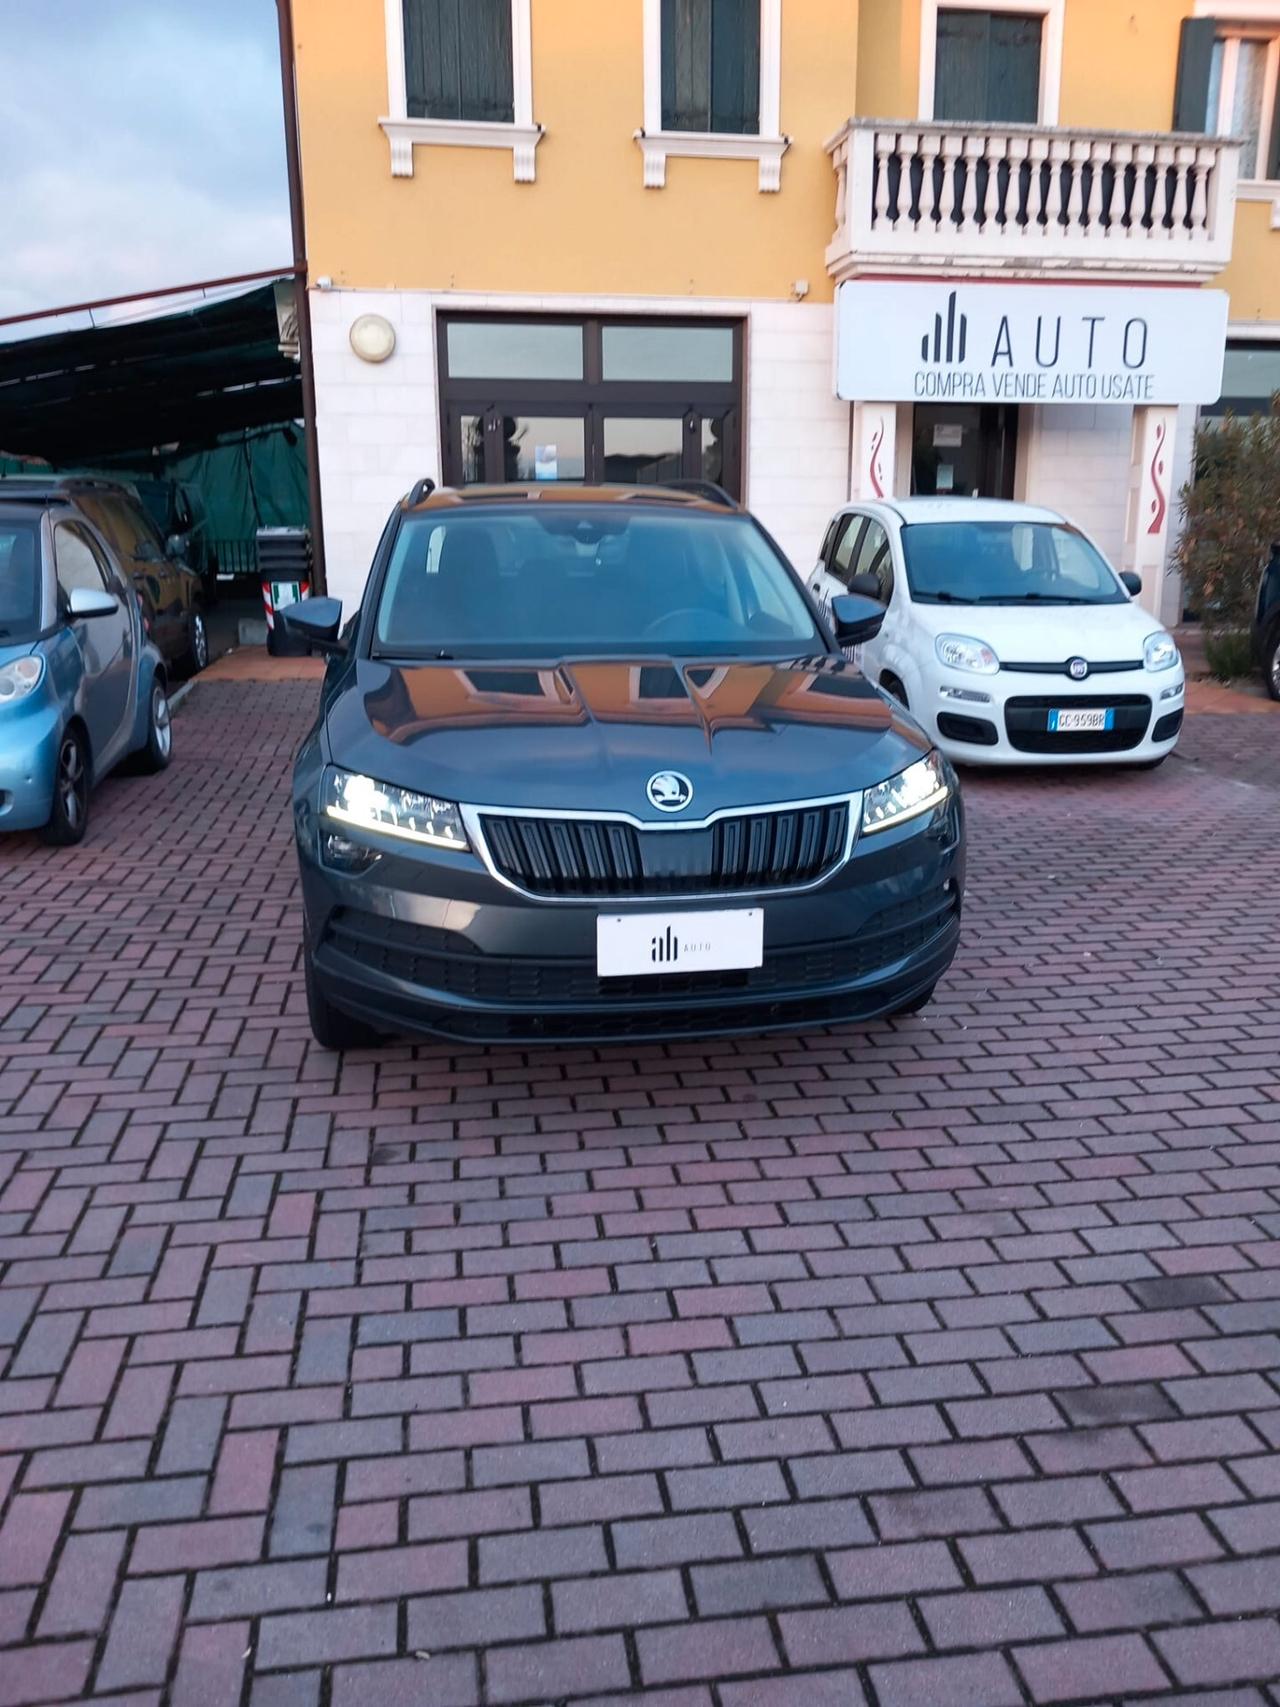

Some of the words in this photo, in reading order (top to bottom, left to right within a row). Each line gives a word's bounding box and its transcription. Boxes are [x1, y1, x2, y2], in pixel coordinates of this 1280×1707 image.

[990, 314, 1148, 370] AUTO
[913, 370, 986, 397] COMPRA
[992, 372, 1048, 398] VENDE
[1051, 373, 1097, 399] AUTO
[1100, 374, 1155, 400] USATE
